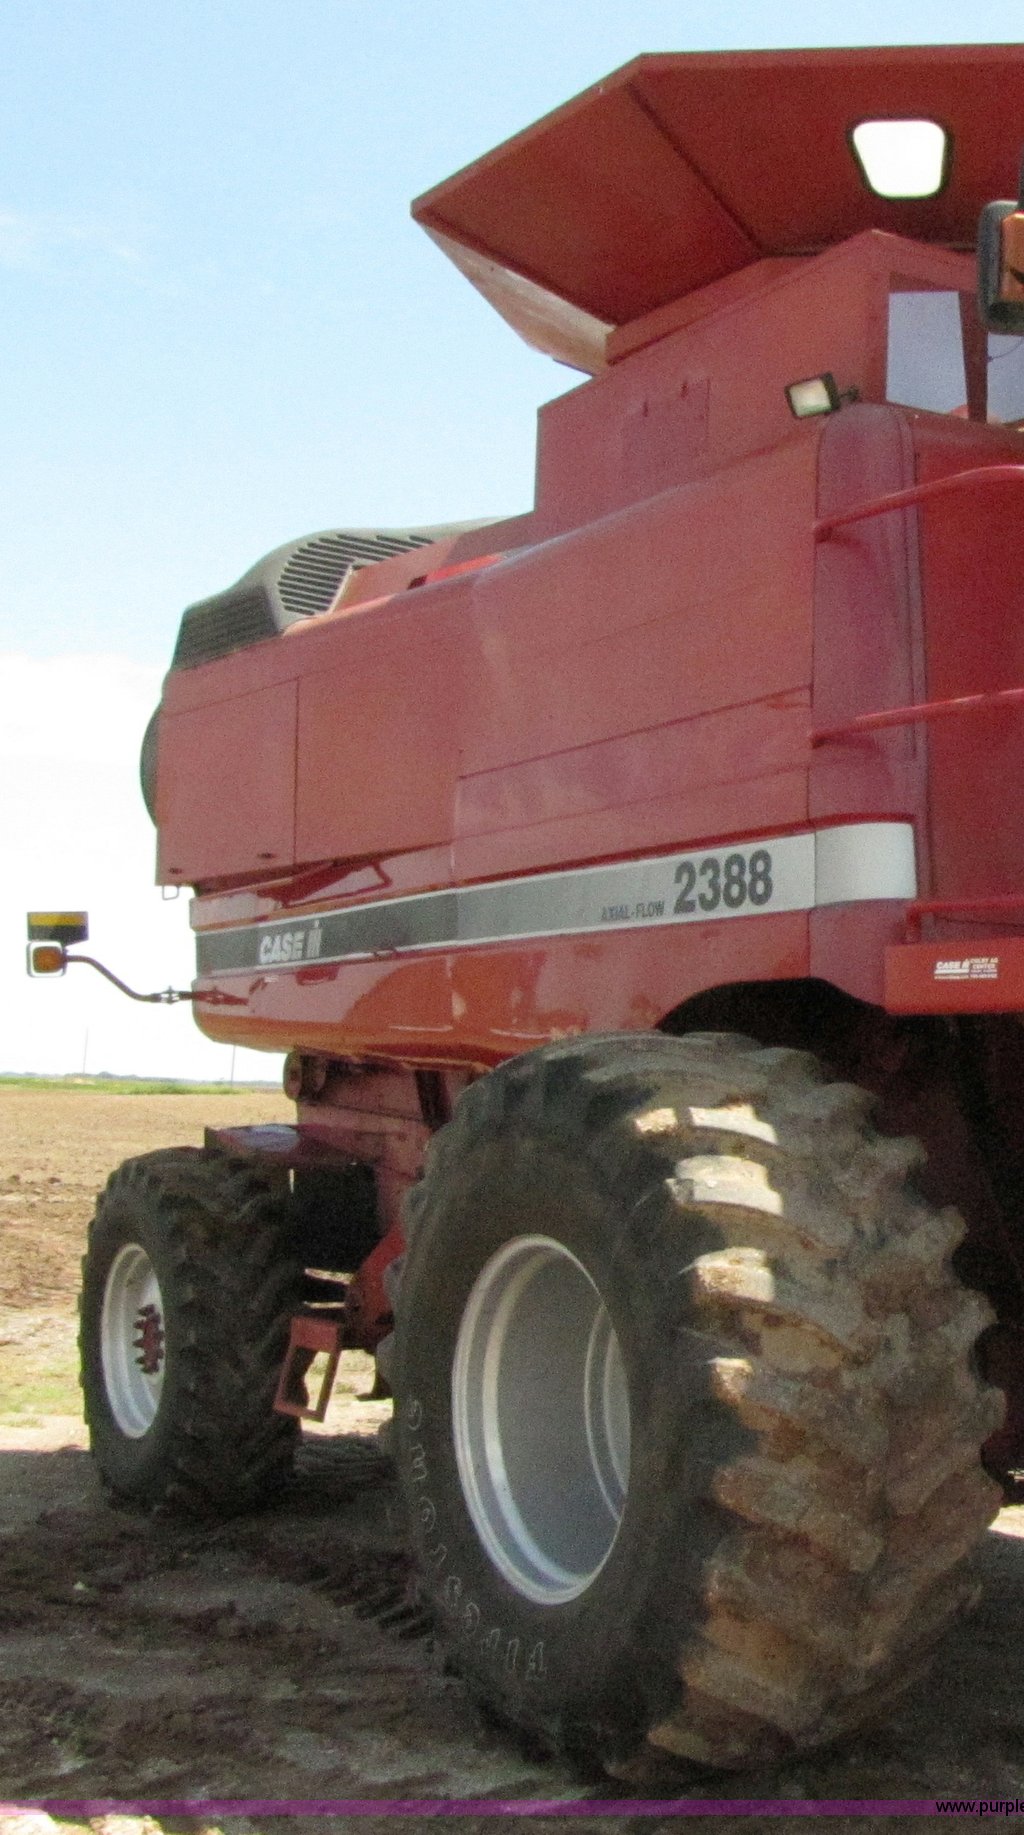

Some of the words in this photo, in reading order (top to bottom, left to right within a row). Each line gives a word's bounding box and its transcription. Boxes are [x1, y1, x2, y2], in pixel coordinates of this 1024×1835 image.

[673, 849, 773, 914] 2388
[601, 900, 665, 921] AXIAL-FLOW
[259, 930, 305, 964] CASE
[936, 961, 962, 969] CASE
